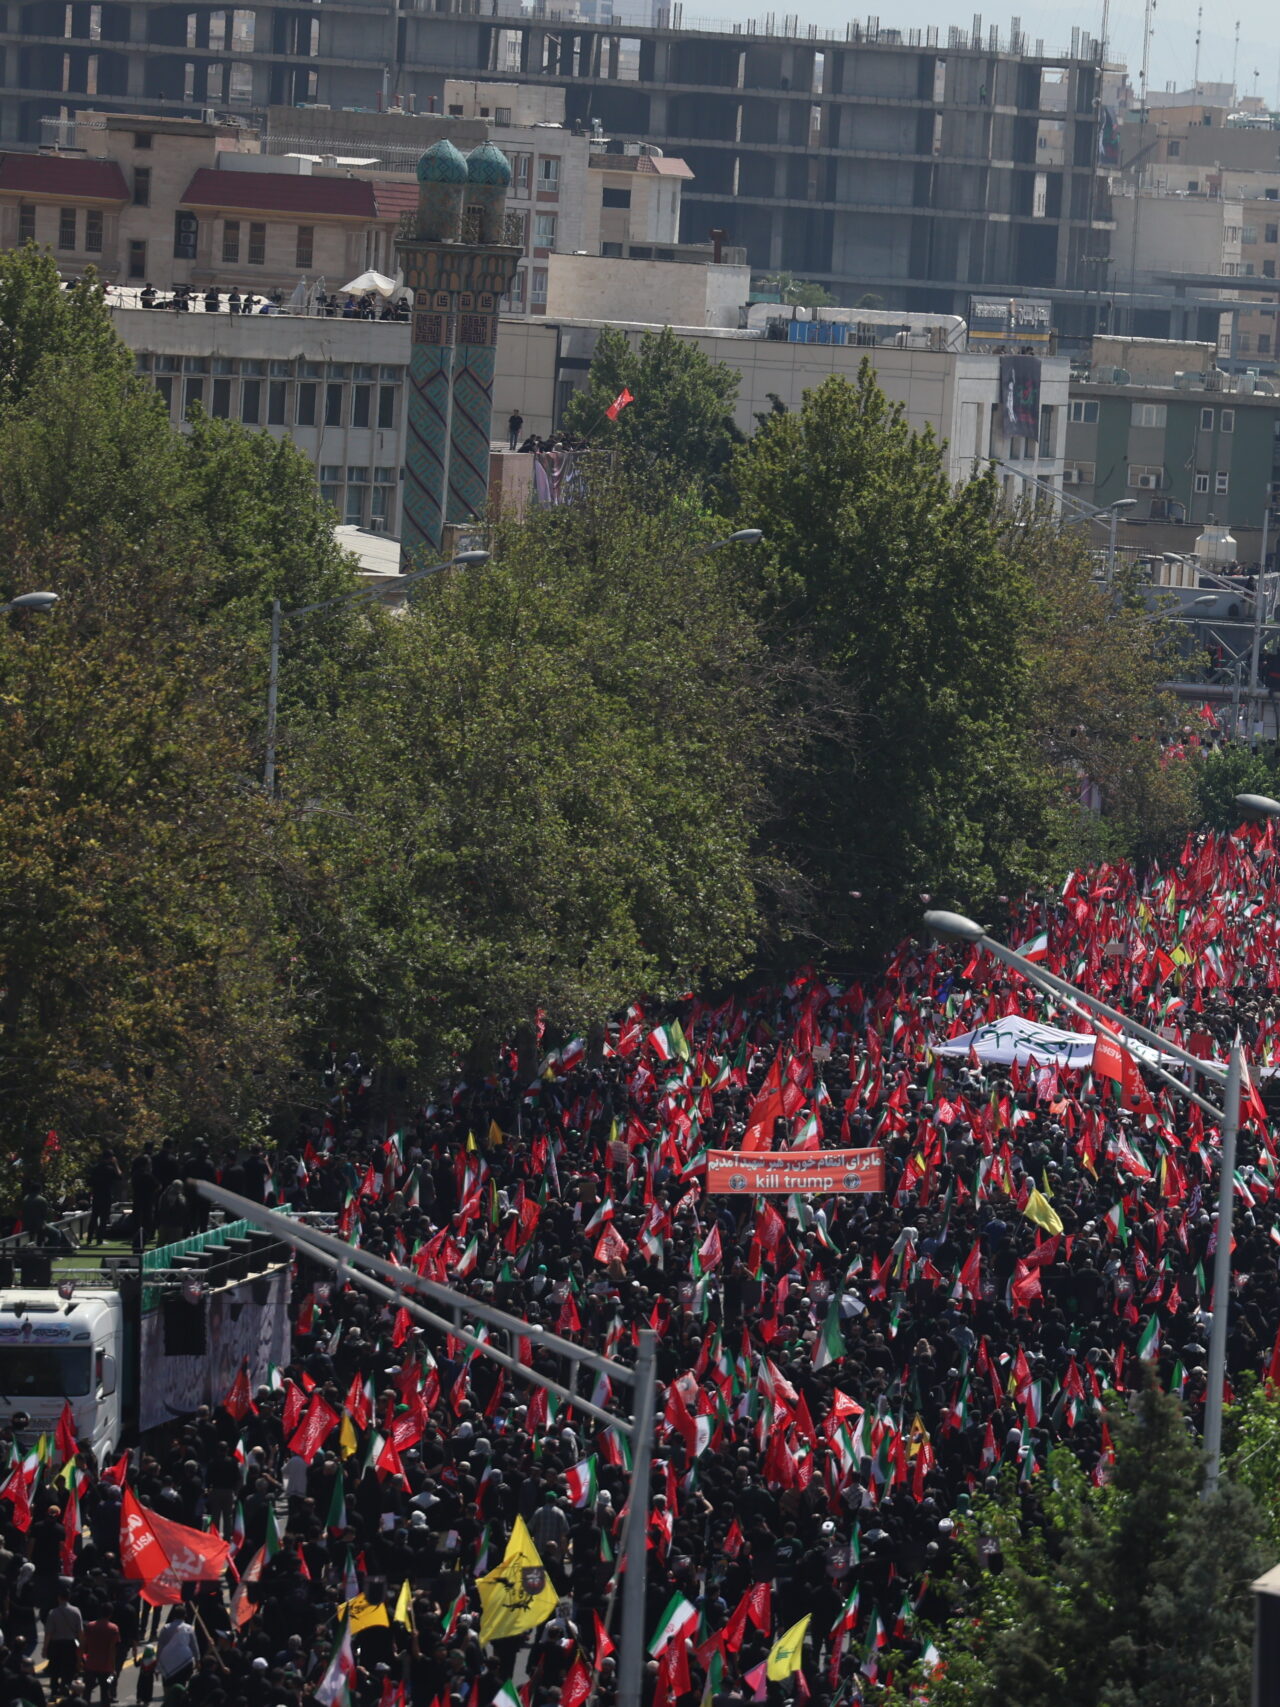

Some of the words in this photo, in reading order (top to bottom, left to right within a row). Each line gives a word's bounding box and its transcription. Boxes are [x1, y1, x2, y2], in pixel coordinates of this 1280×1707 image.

[708, 1154, 739, 1172] آمدیم
[740, 1156, 766, 1170] شهید
[766, 1156, 791, 1172] رهبر
[791, 1156, 816, 1171] خون
[817, 1154, 845, 1170] انتقام
[846, 1154, 871, 1171] برای
[756, 1174, 779, 1189] kill
[783, 1175, 834, 1191] trump
